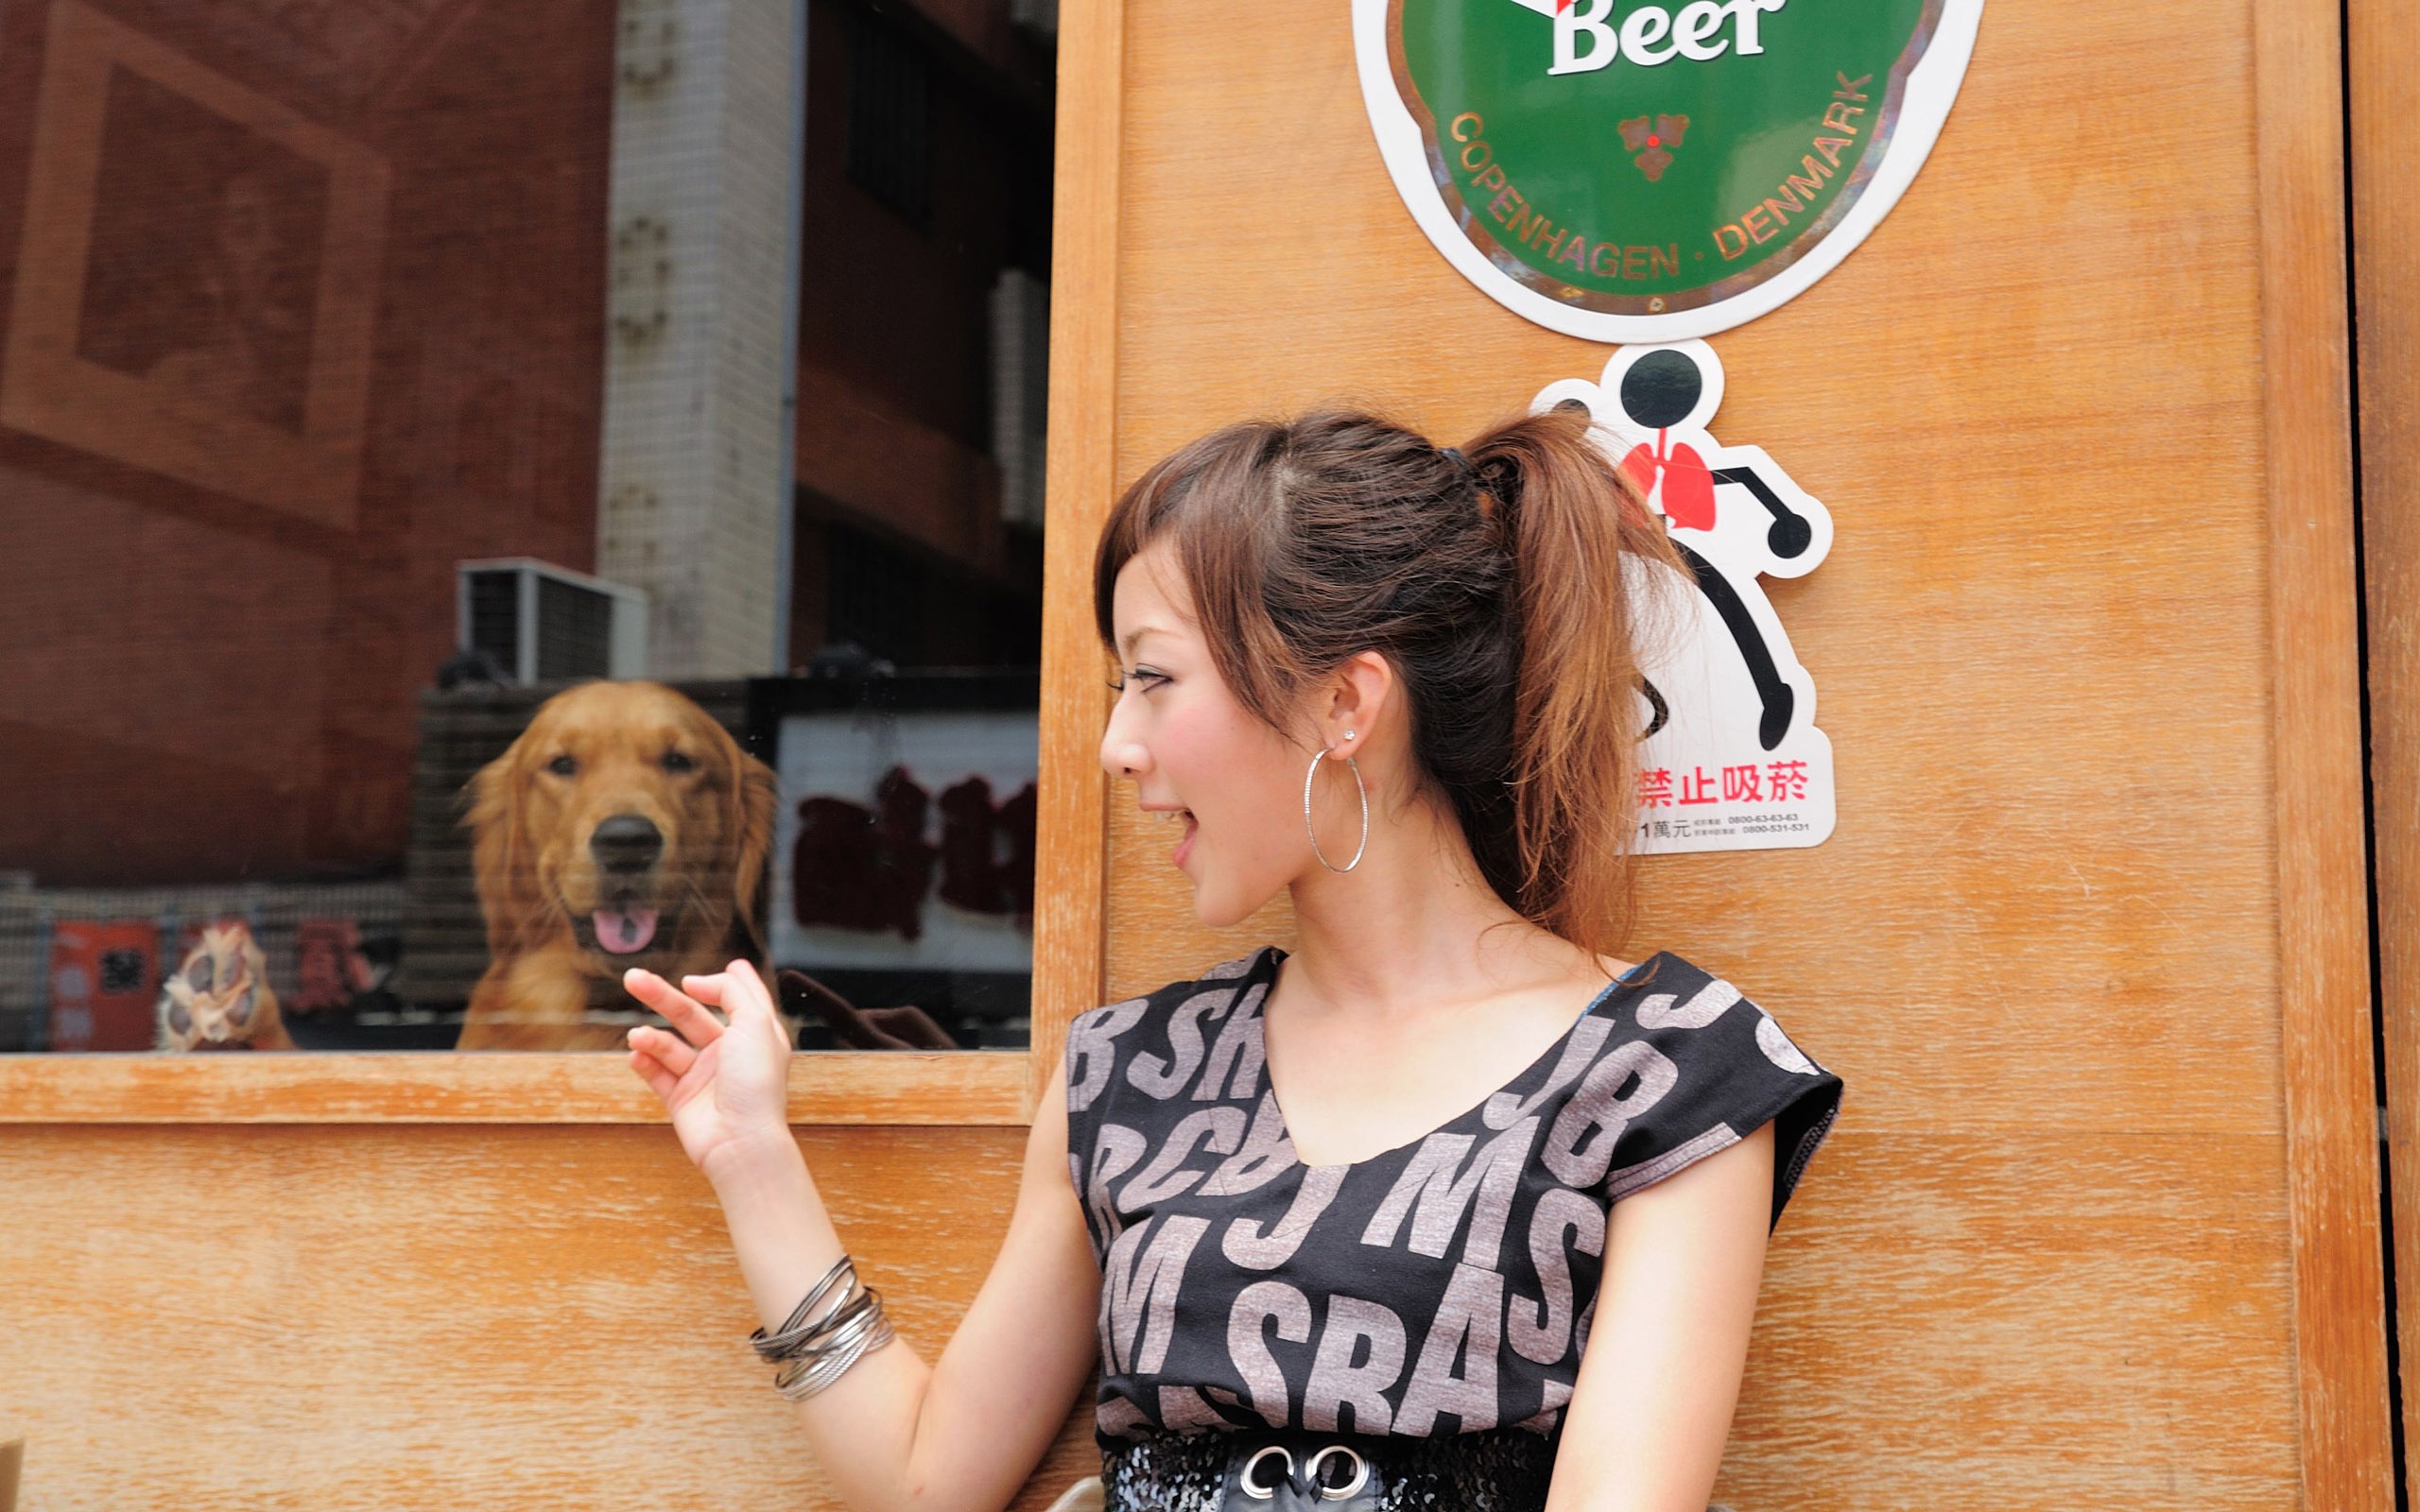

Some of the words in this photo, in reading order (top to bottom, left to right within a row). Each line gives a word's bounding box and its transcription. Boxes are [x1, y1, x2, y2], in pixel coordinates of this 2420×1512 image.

[1547, 0, 1786, 75] Beer
[1450, 112, 1680, 280] COPENHAGEN
[1713, 70, 1873, 261] DENMARK
[1635, 760, 1808, 809] 禁止吸菸
[1728, 814, 1799, 824] 0800-63-63-63
[1742, 823, 1810, 834] 0800-531-531
